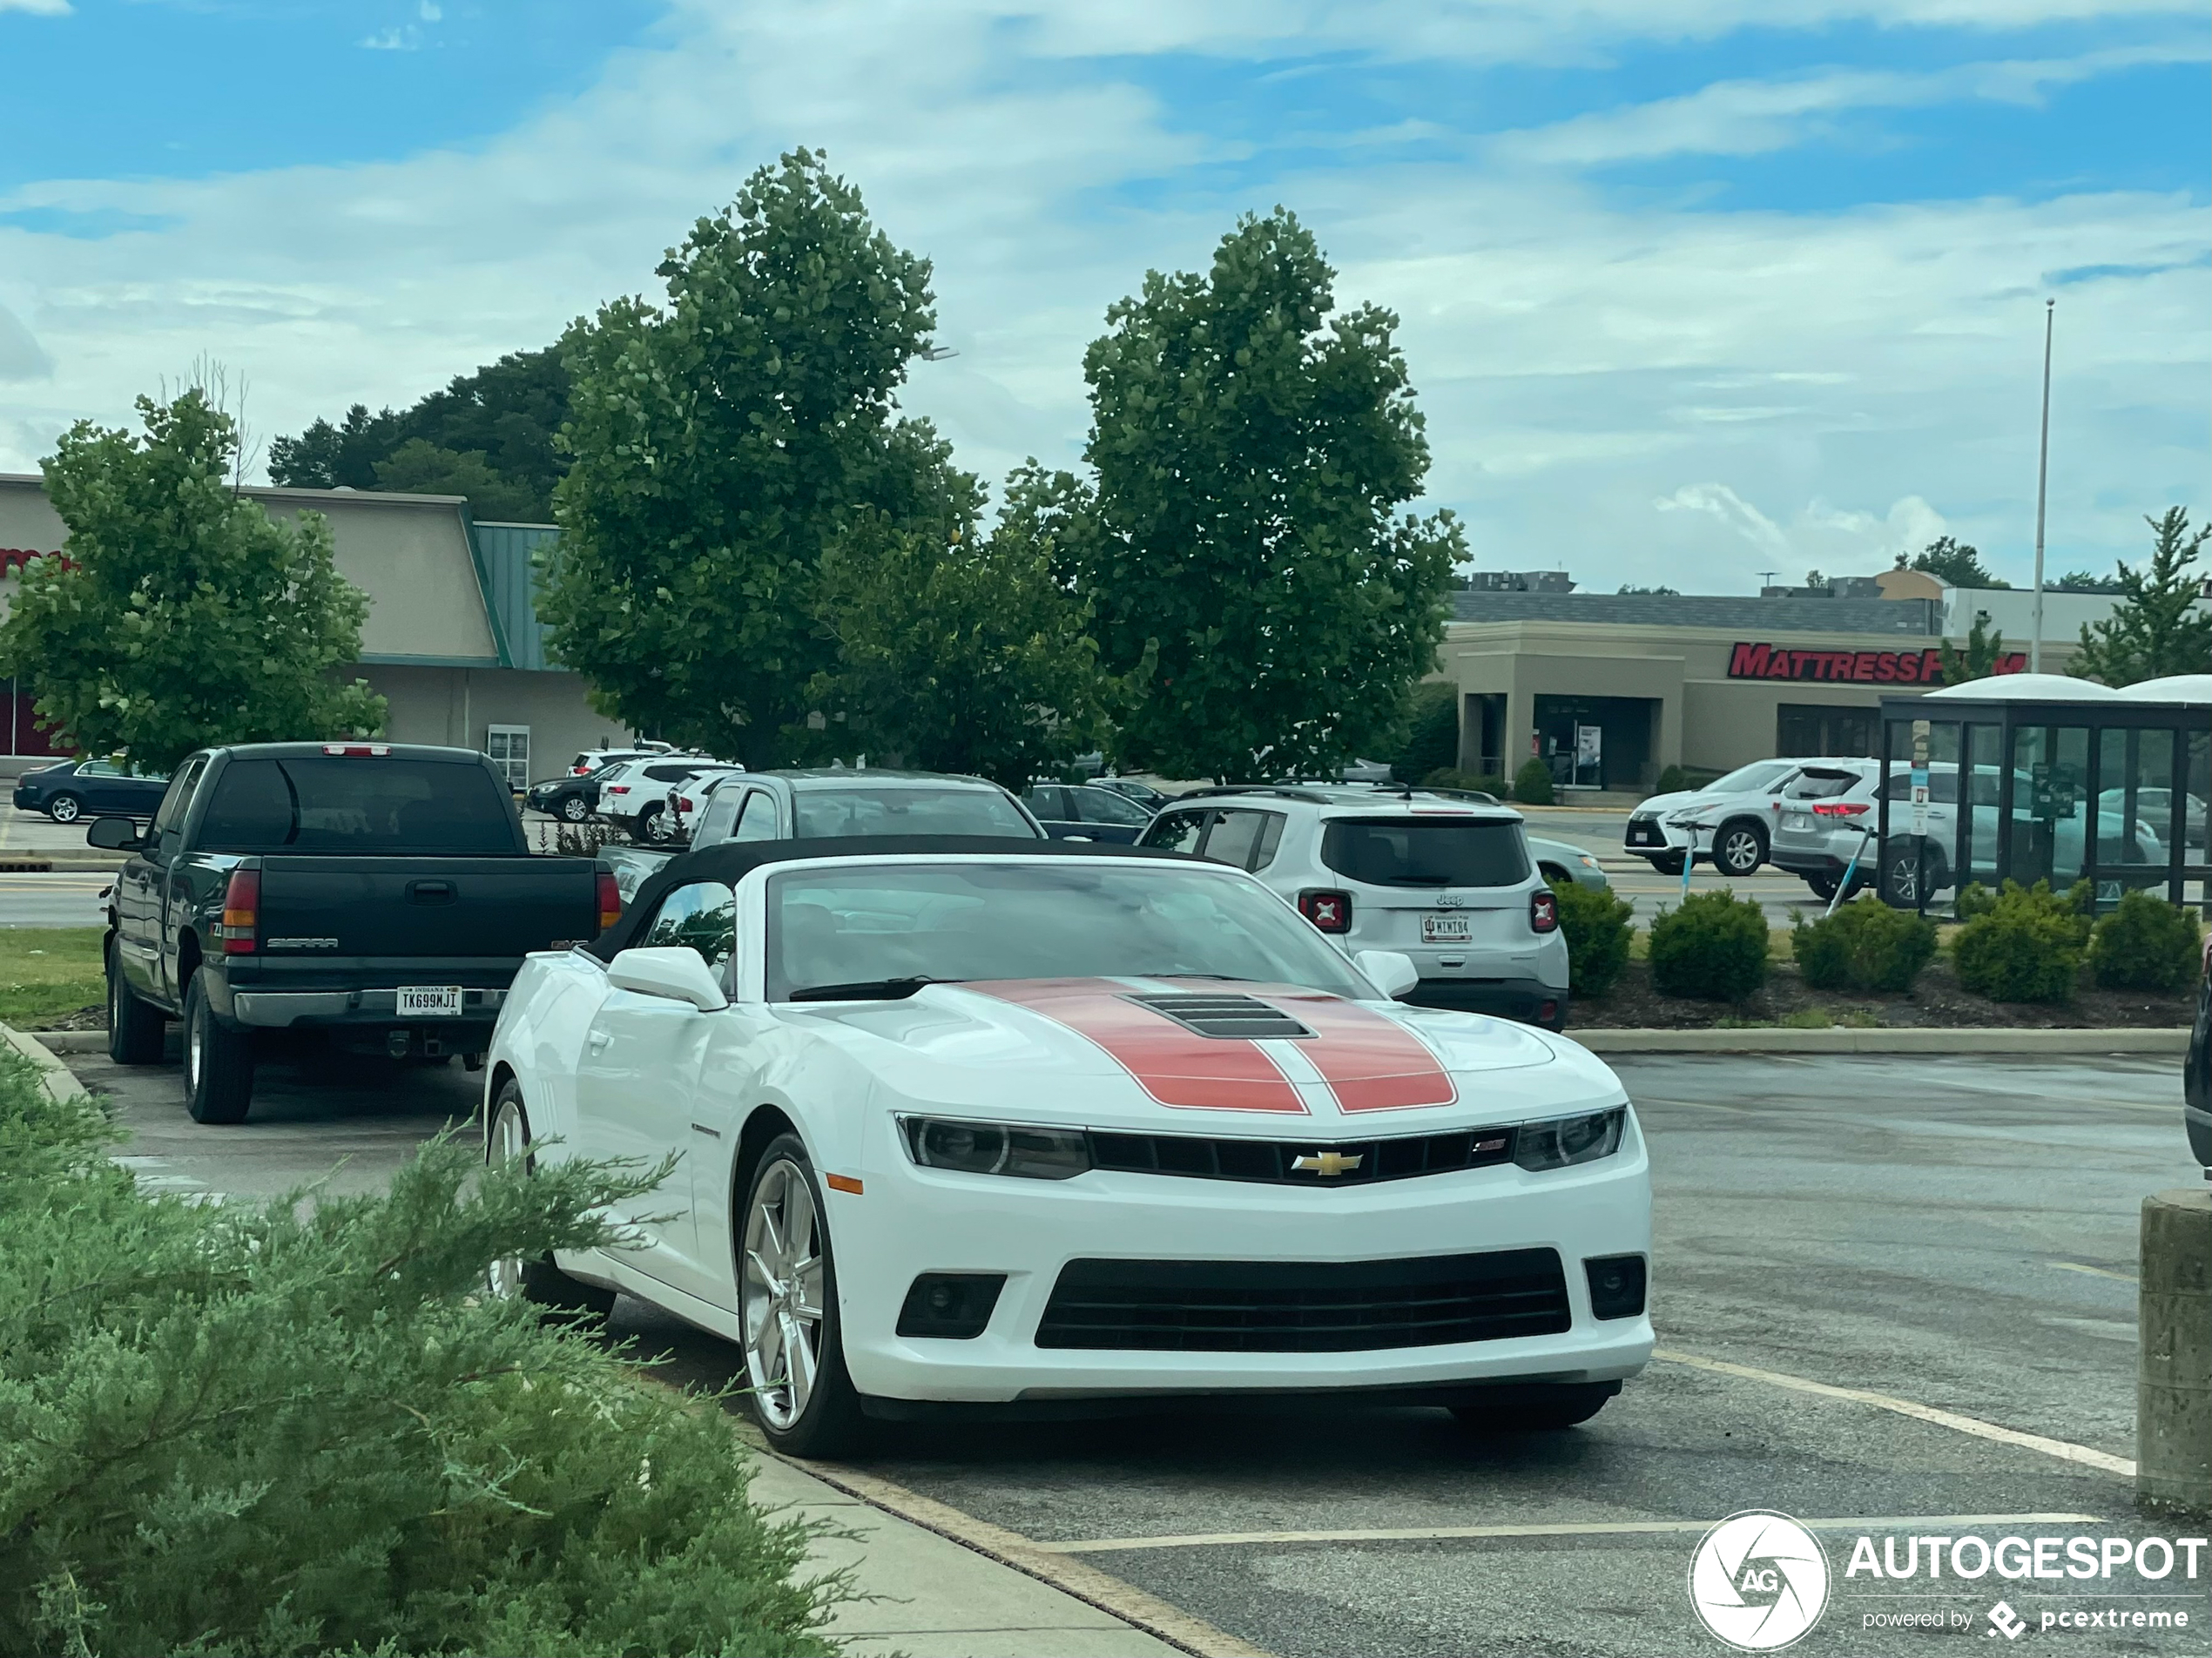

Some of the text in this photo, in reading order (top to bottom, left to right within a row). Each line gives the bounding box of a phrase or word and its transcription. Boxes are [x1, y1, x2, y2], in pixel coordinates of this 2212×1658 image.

[1730, 643, 1919, 682] MATTRESS
[1437, 894, 1463, 906] Jeep
[267, 938, 339, 947] SIERRA
